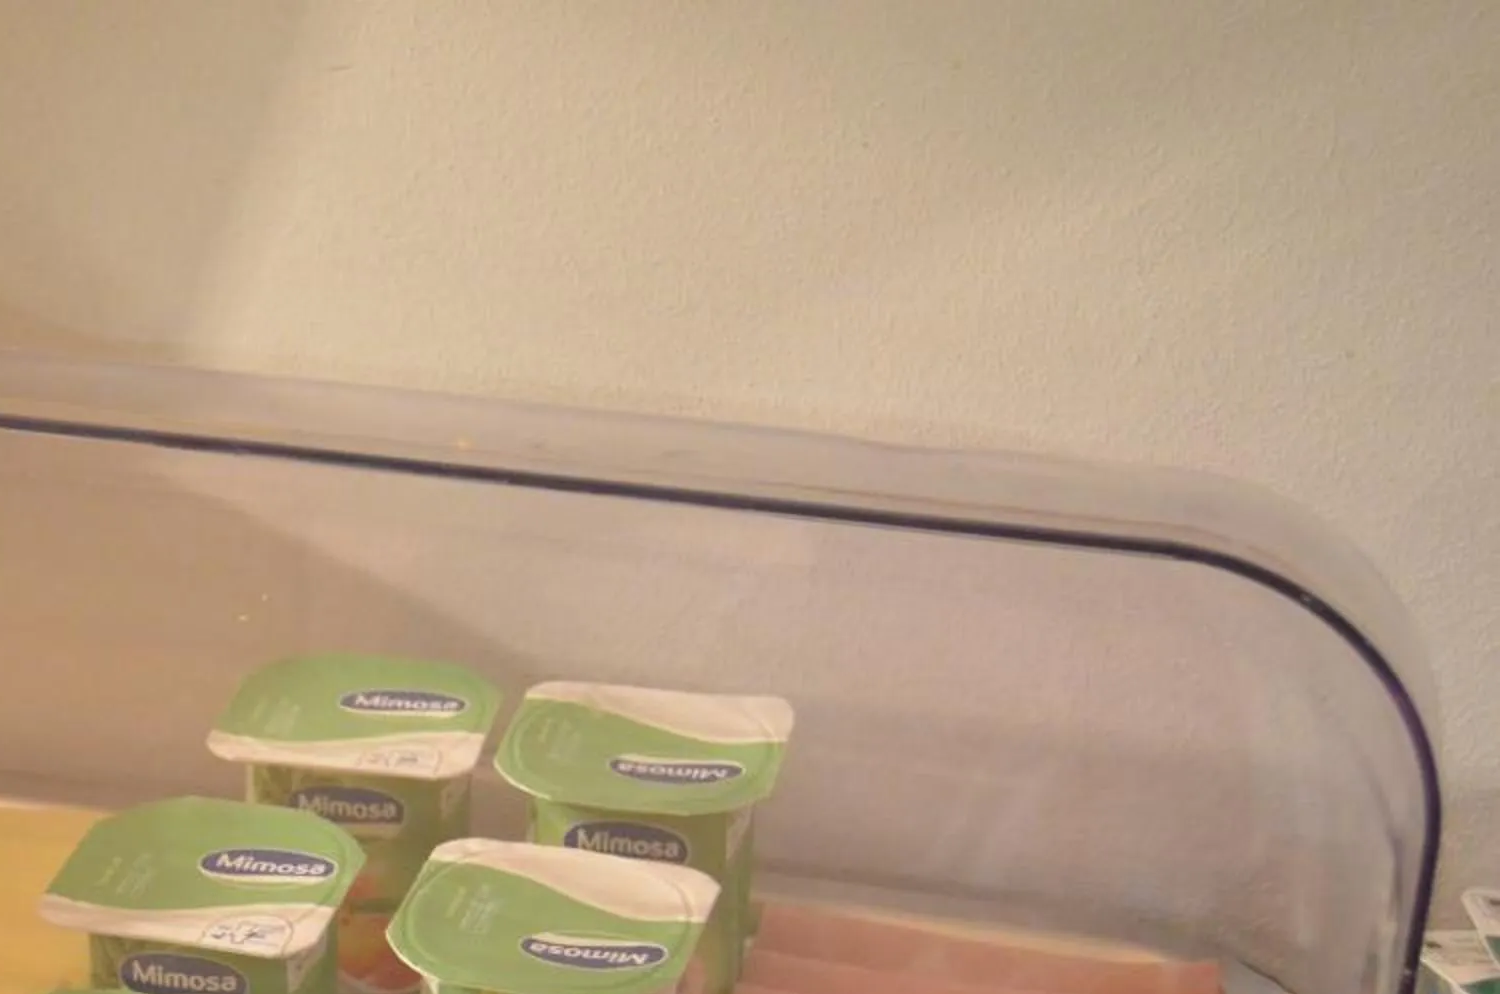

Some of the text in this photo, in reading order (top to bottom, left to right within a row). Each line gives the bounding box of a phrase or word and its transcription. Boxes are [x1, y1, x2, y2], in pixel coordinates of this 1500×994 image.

[355, 693, 459, 712] Mimosa
[616, 762, 728, 780] Mimosa
[577, 828, 680, 858] Mimosa
[215, 853, 327, 877] Mimosa
[530, 941, 650, 966] Mimosa
[131, 960, 239, 993] Mimosa
